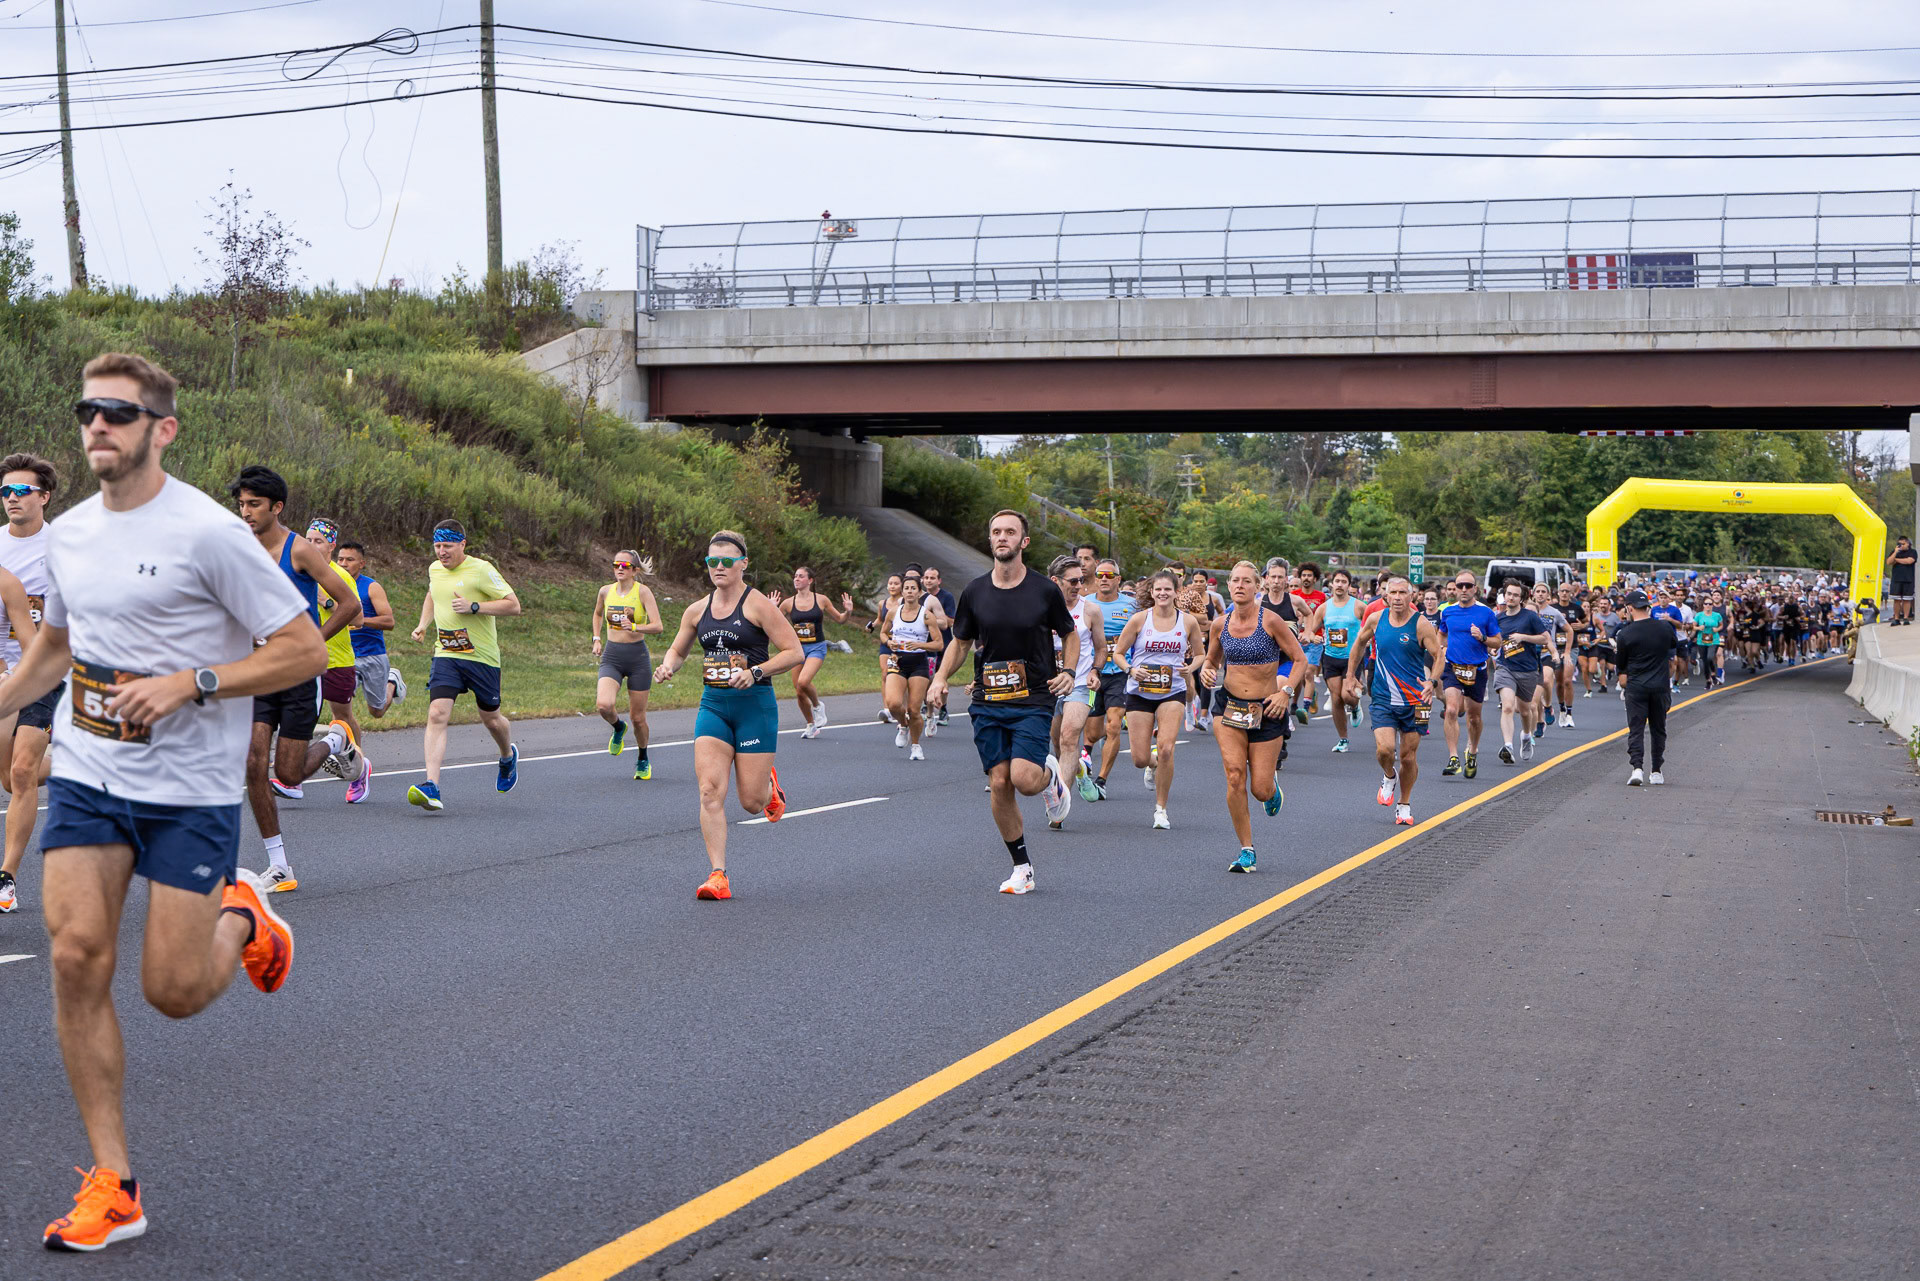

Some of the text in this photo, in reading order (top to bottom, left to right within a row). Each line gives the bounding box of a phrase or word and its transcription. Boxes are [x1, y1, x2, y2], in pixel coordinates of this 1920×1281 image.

[1411, 556, 1422, 564] 206
[1413, 574, 1419, 583] 2
[701, 629, 739, 642] PRINCETON
[1145, 641, 1182, 650] LEONIA
[988, 673, 1020, 686] 132
[1231, 711, 1254, 723] 24
[740, 738, 760, 747] HOKA
